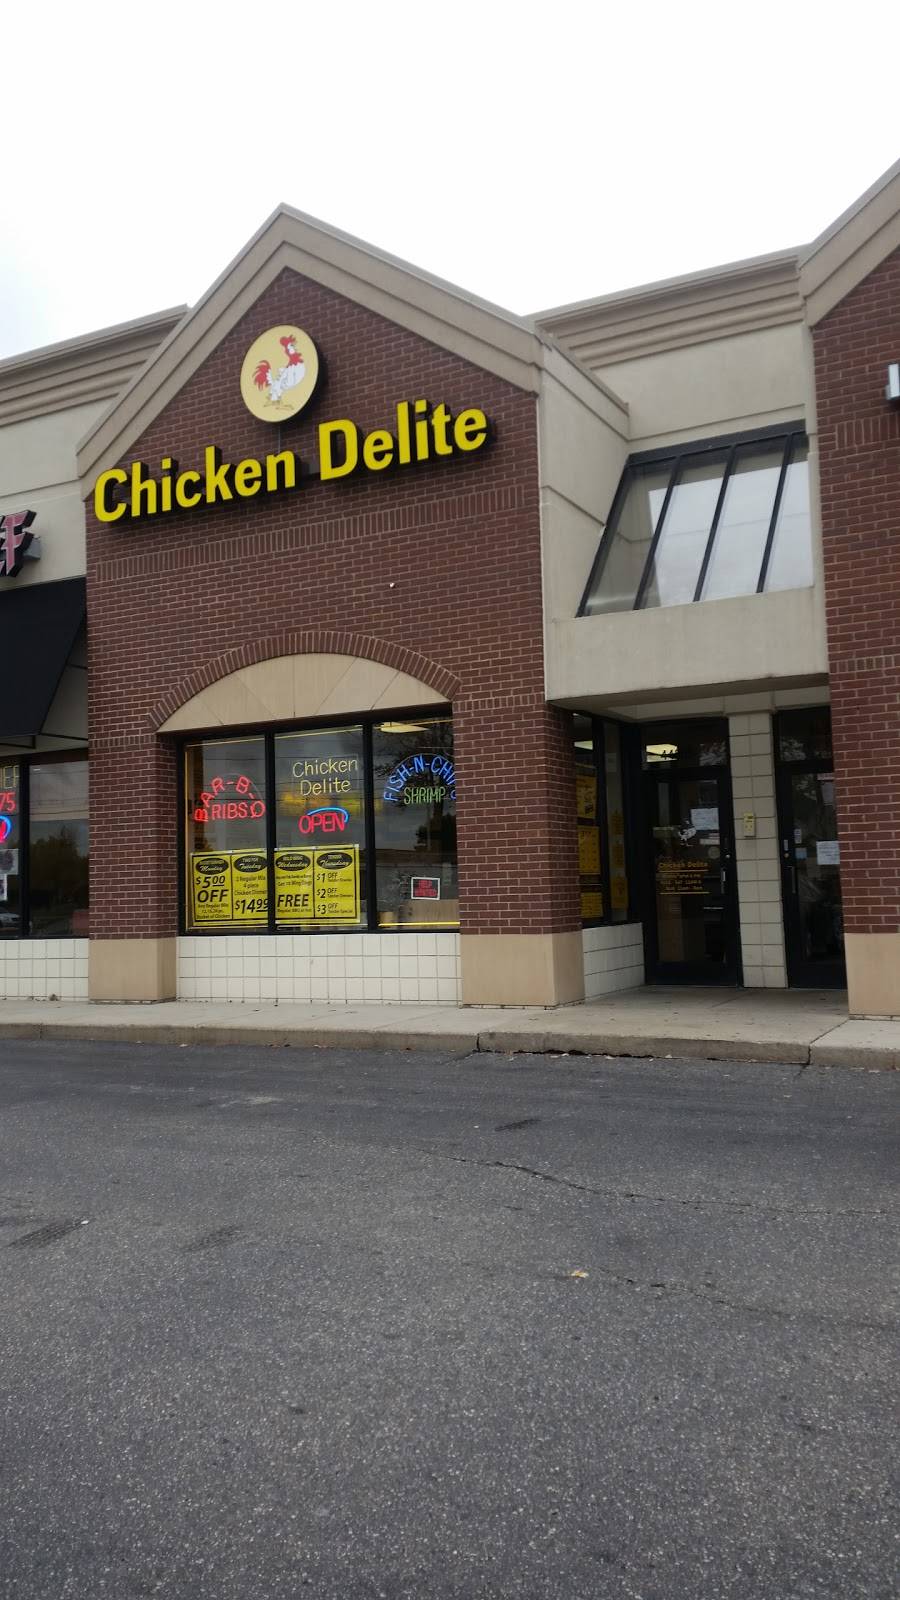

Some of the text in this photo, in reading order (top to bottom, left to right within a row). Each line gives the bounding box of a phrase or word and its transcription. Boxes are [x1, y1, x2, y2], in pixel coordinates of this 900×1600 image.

[93, 399, 488, 522] Chicken Delite
[292, 758, 358, 778] Chicken
[300, 776, 352, 796] Delite
[403, 786, 446, 805] SHRIMP
[212, 802, 248, 820] RIBS
[298, 811, 346, 834] OPEN
[316, 873, 326, 883] $1
[197, 889, 229, 903] OFF
[277, 893, 310, 907] FREE
[316, 888, 326, 899] $2
[317, 904, 327, 915] $3
